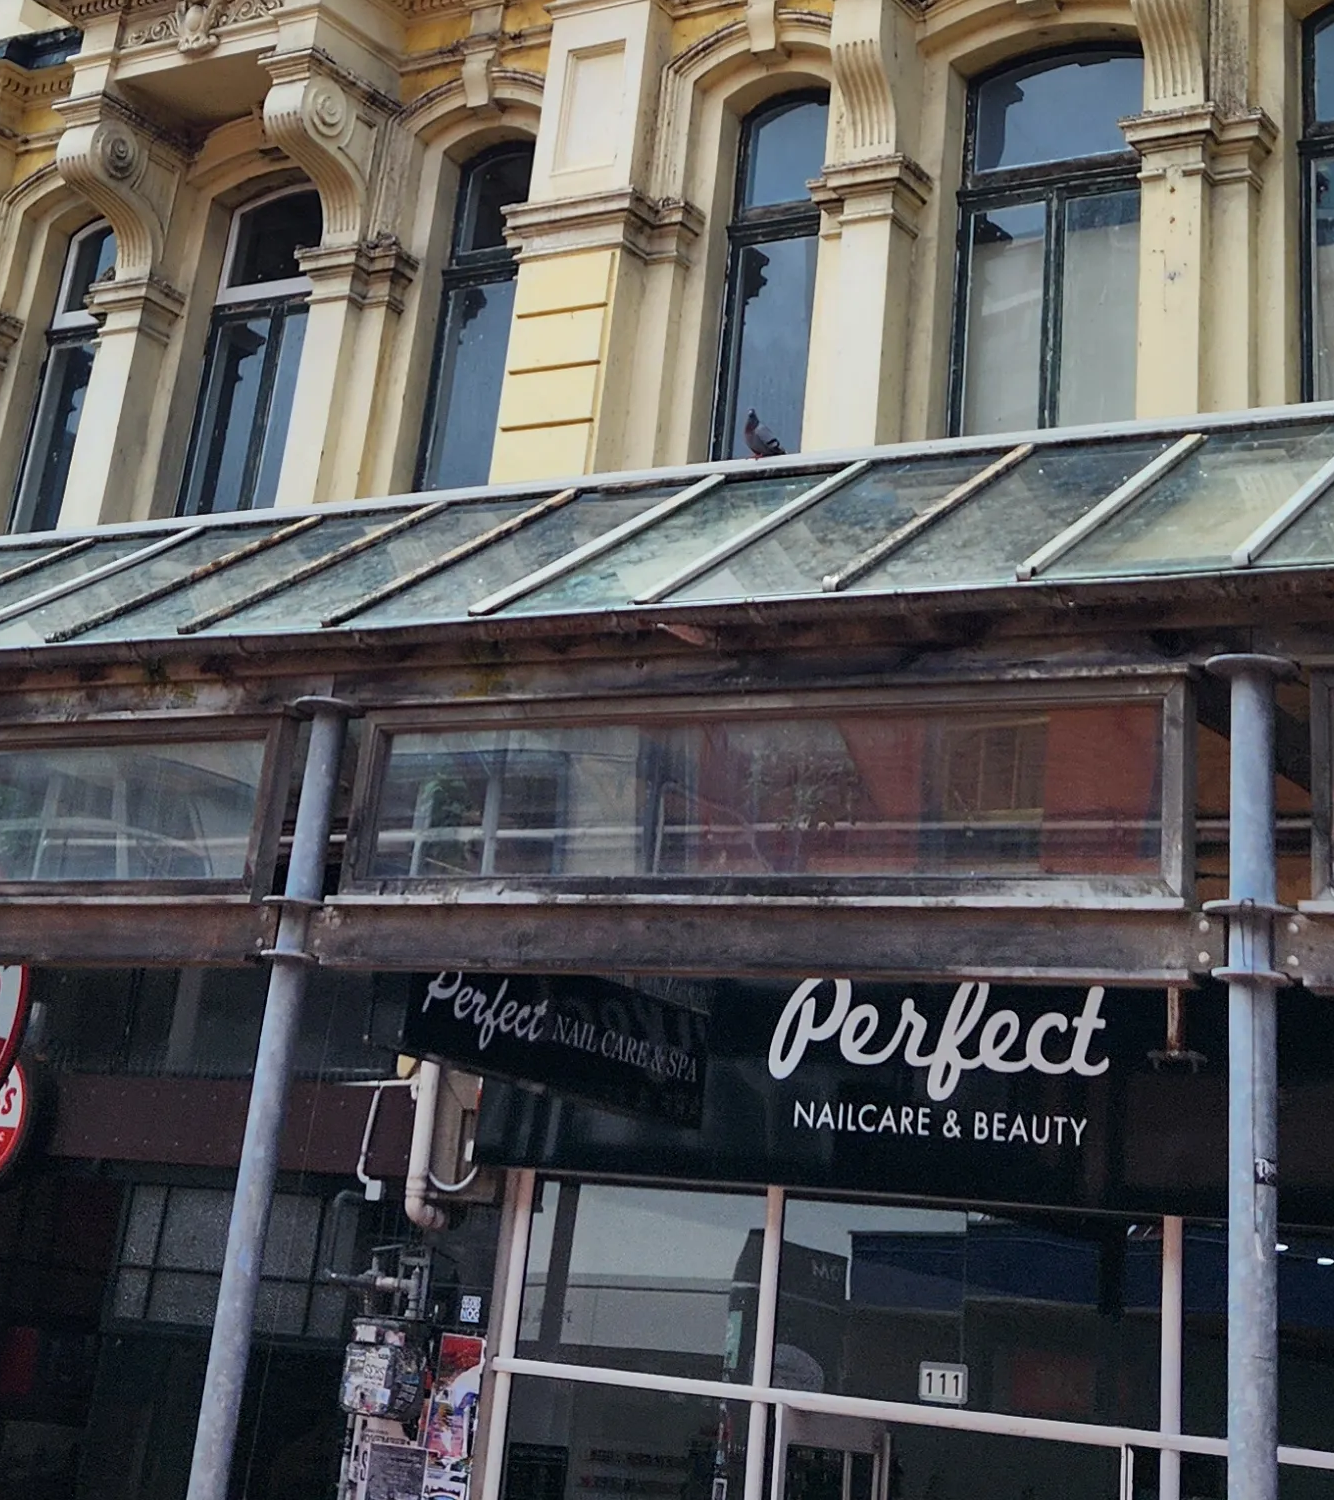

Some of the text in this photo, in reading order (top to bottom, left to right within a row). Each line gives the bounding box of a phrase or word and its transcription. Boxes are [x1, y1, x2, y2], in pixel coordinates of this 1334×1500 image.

[421, 971, 698, 1083] Perfect NAIL CARE & SPA
[767, 977, 1110, 1102] Perfect
[792, 1100, 1088, 1147] NAILCARE & BEAUTY
[925, 1371, 960, 1397] 111
